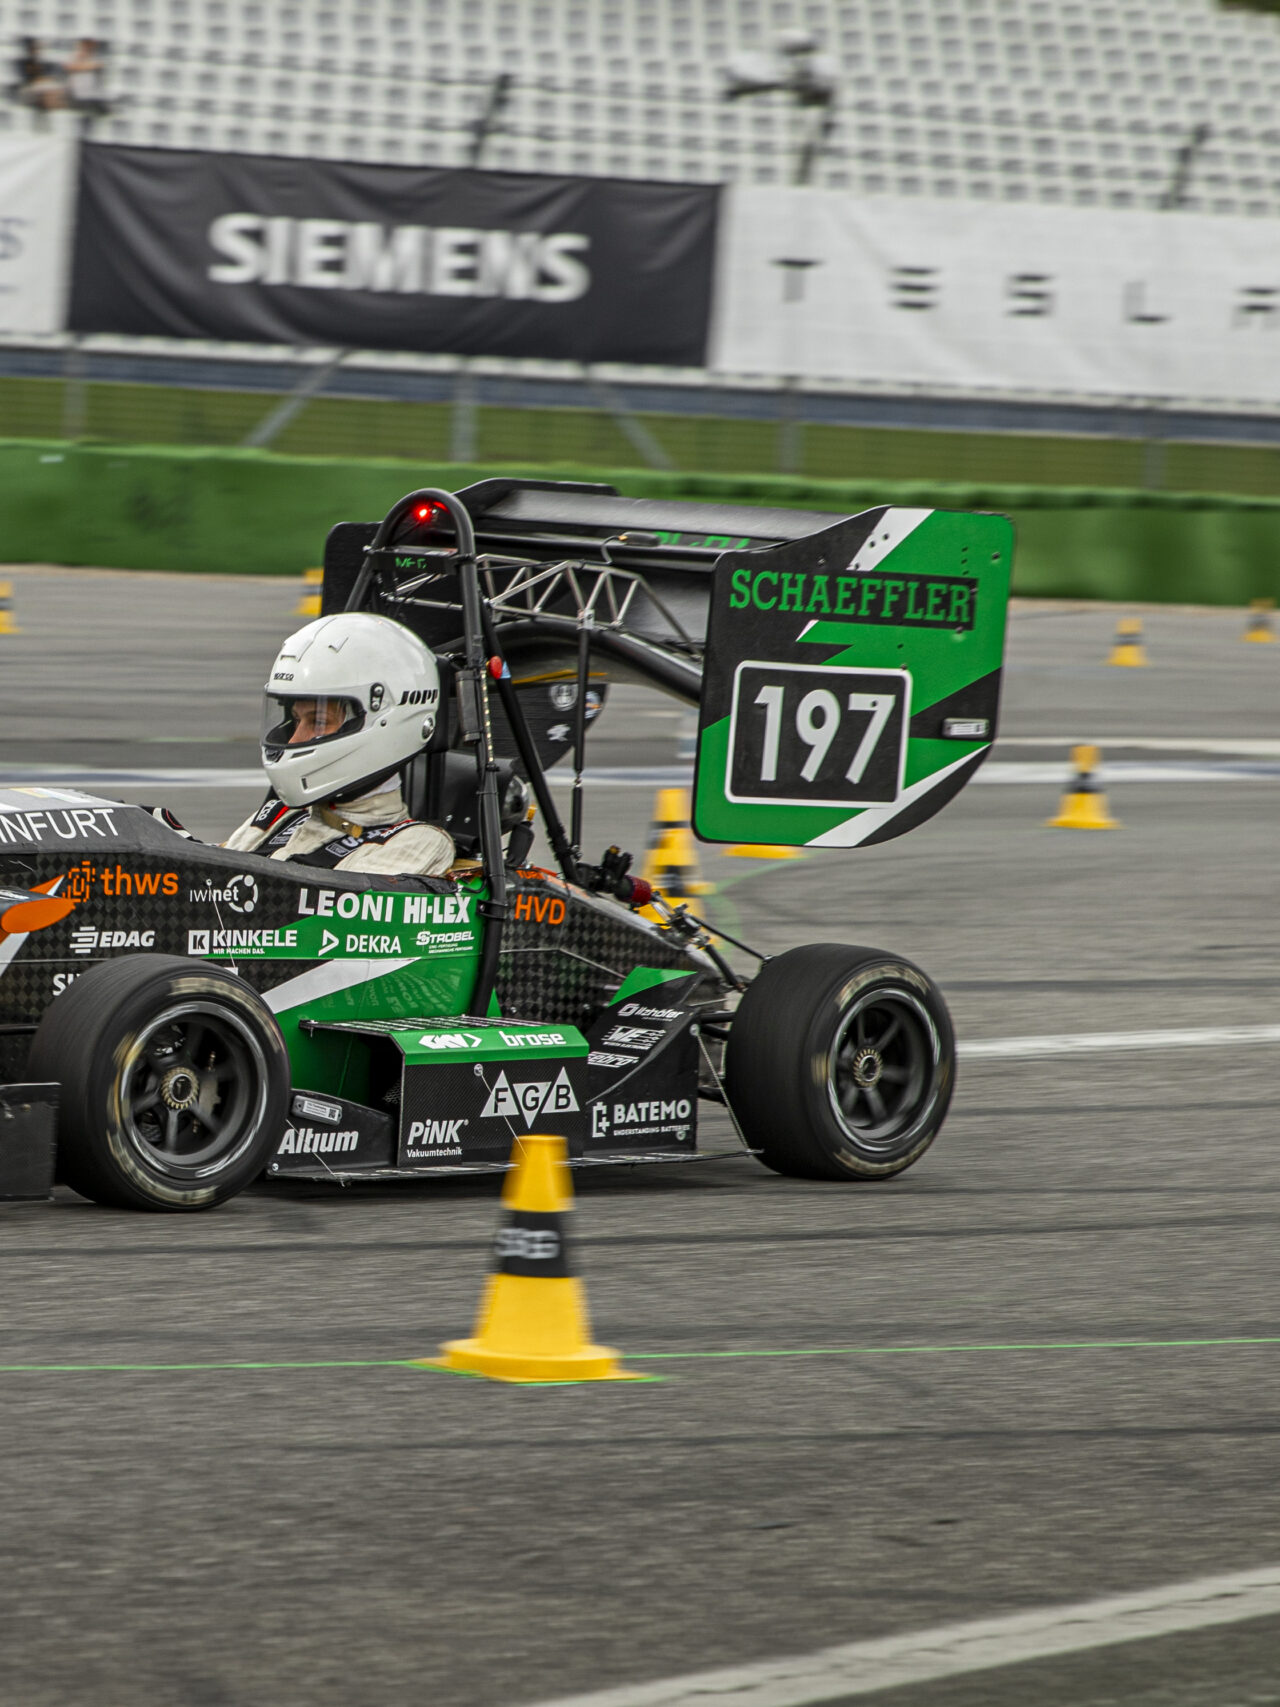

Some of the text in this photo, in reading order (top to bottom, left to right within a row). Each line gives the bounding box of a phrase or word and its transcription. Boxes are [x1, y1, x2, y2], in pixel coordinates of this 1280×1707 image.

[209, 213, 591, 302] SIEMENS
[729, 569, 972, 623] SCHAEFFLER
[754, 686, 896, 784] 197
[100, 865, 179, 895] thws
[298, 888, 394, 923] LEONI
[514, 893, 566, 925] HVD
[99, 930, 155, 948] EDAG
[213, 930, 298, 947] KINKELE
[346, 934, 402, 954] DEKRA
[498, 1030, 567, 1047] brose
[613, 1099, 692, 1124] BATEMO
[277, 1128, 359, 1155] Altium
[407, 1147, 463, 1158] Vakuumtechnik
